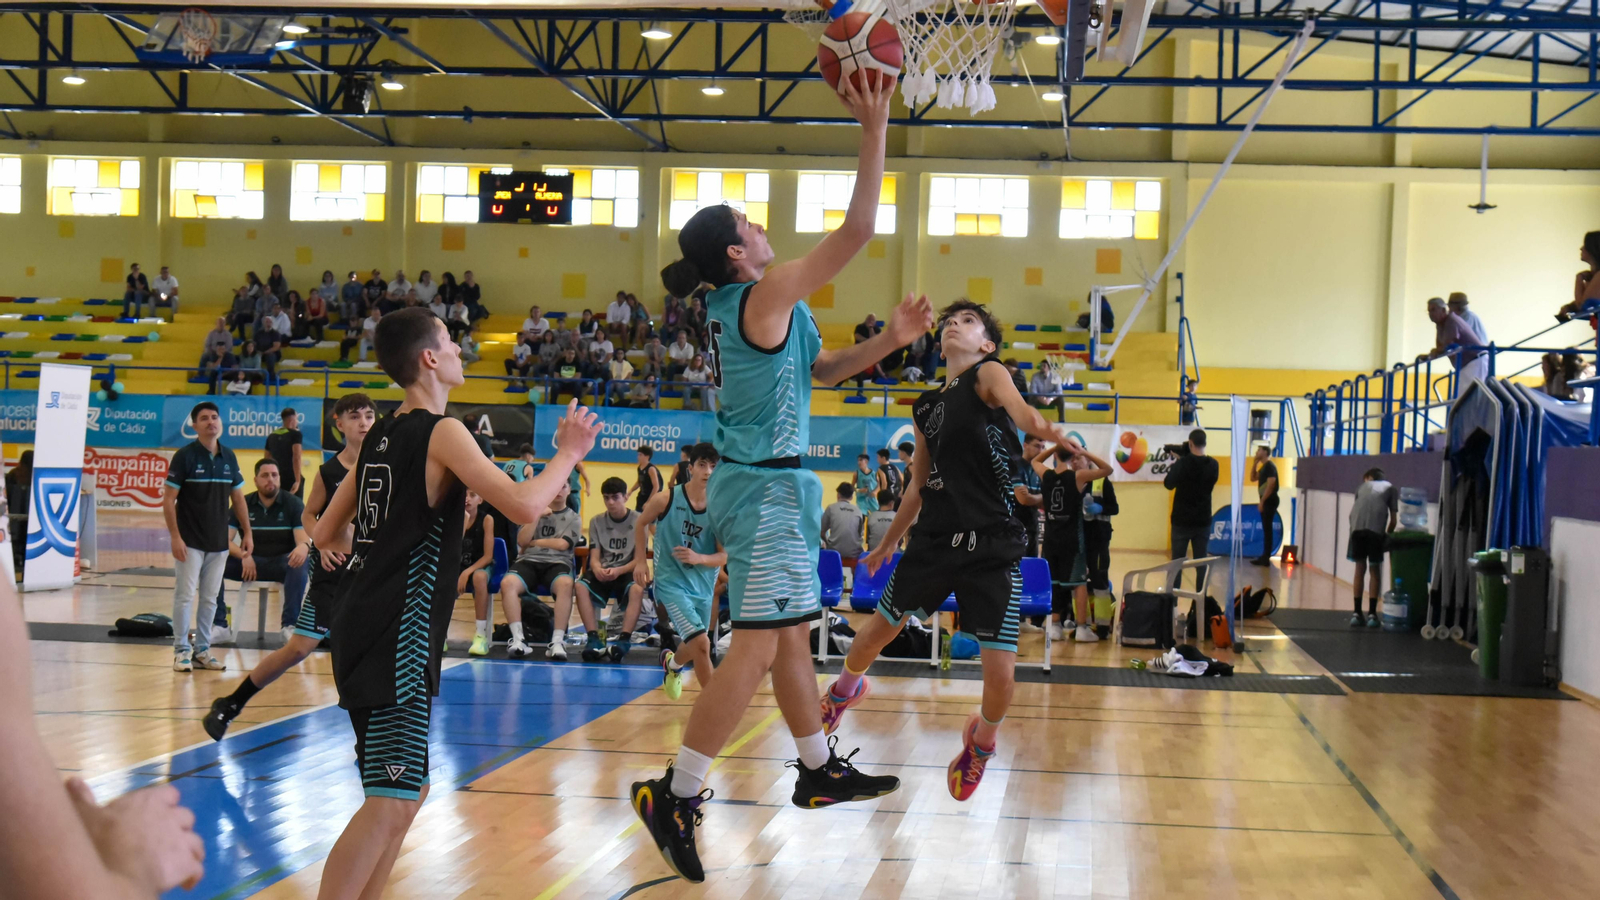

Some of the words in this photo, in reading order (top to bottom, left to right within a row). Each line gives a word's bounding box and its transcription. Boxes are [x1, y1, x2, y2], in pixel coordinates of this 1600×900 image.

[104, 407, 157, 420] Diputación
[229, 408, 305, 423] balonceo
[104, 422, 116, 432] de
[119, 422, 146, 434] Cádiz
[601, 420, 681, 439] baloncesto
